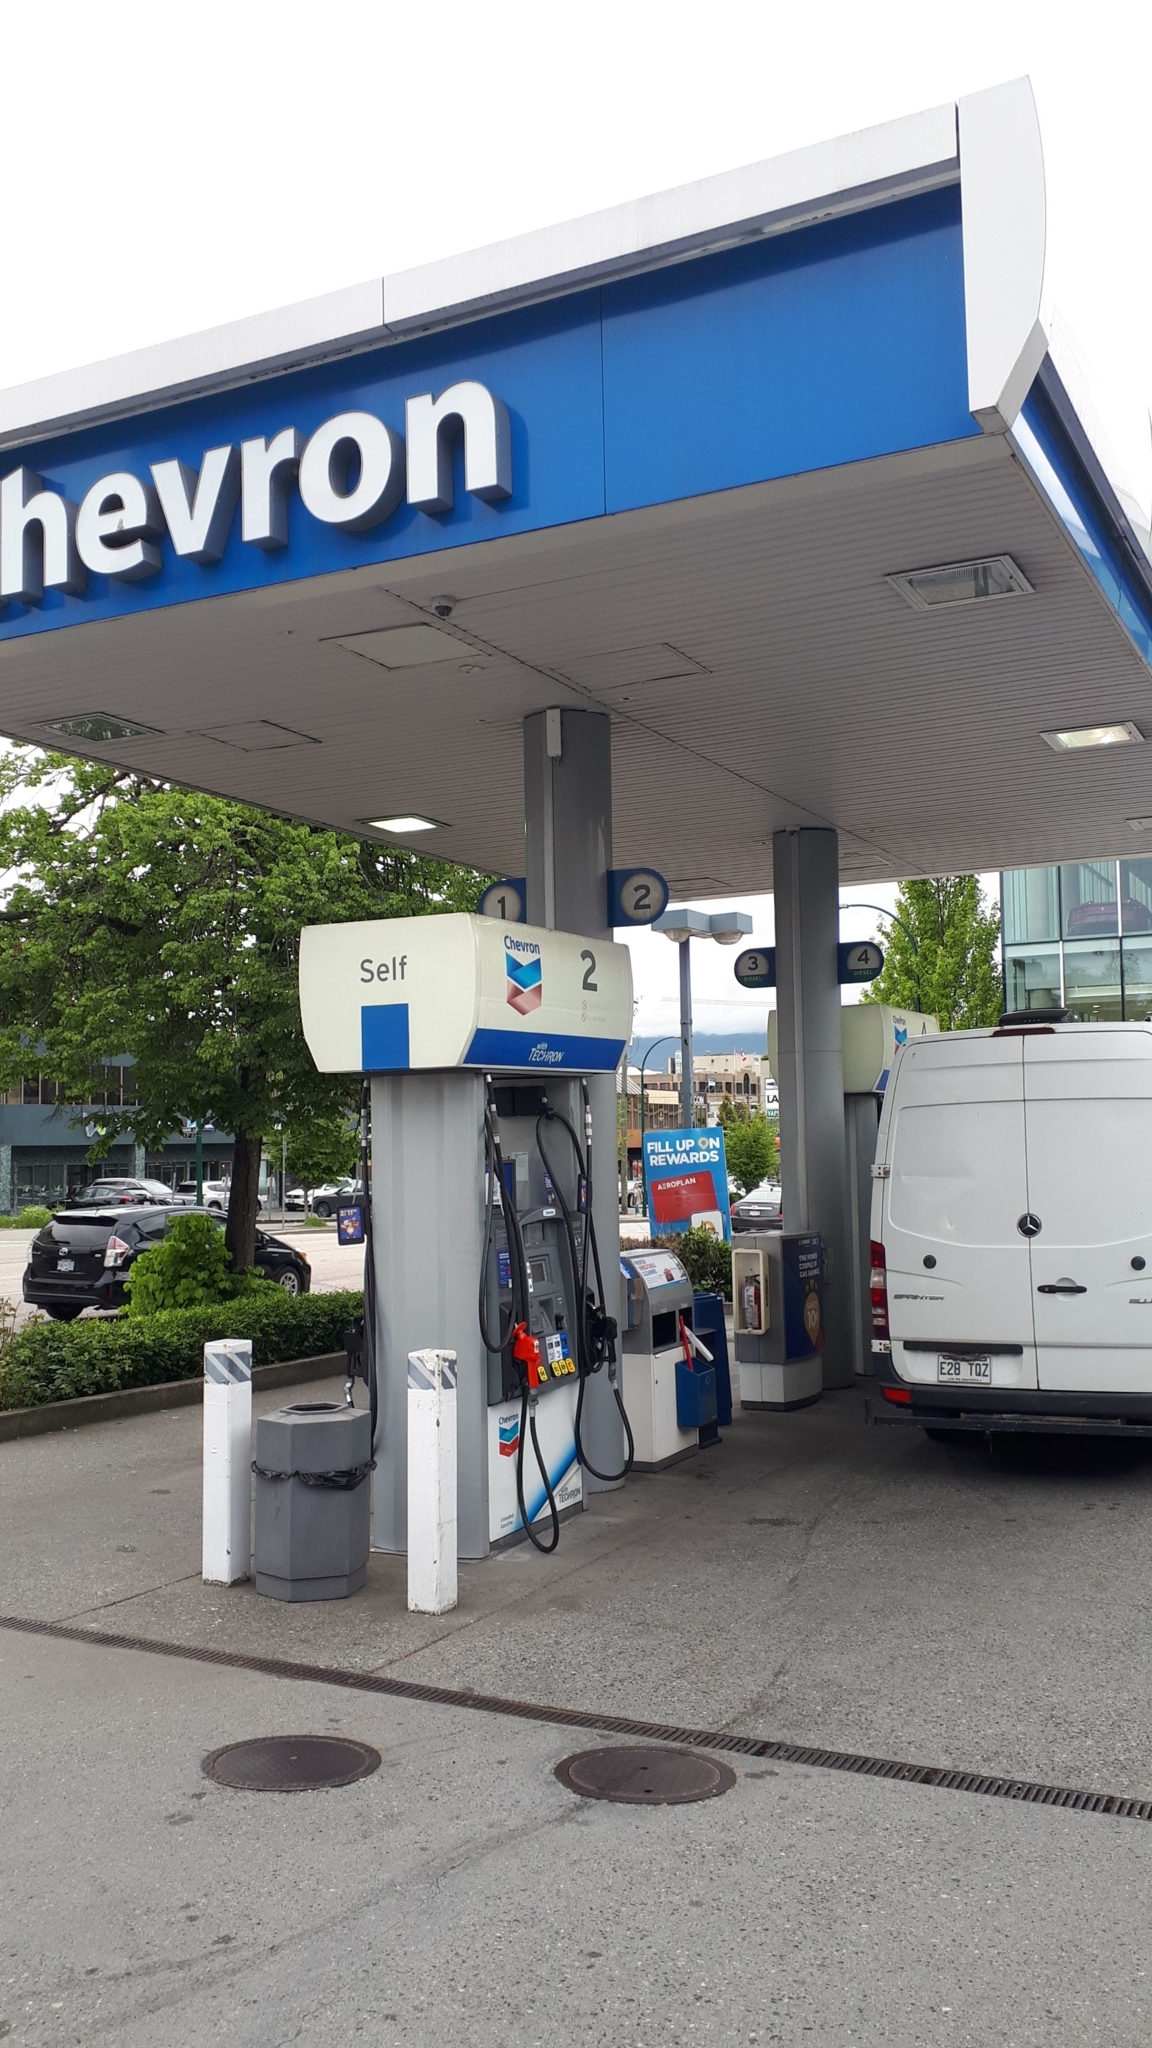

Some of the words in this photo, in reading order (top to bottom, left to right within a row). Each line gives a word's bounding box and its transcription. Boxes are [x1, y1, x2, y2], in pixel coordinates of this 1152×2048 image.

[0, 380, 511, 603] hevron
[632, 883, 652, 911] 2
[497, 896, 506, 919] 1
[504, 935, 541, 955] Chevron
[747, 955, 759, 971] 3
[857, 949, 870, 965] 4
[360, 955, 408, 984] Self
[580, 949, 598, 992] 2
[537, 1042, 548, 1051] with
[528, 1048, 565, 1064] TECHRON
[646, 1140, 674, 1154] FILL
[675, 1138, 695, 1152] UP
[698, 1136, 720, 1150] ON
[649, 1150, 719, 1167] REWARDS
[657, 1177, 696, 1191] AEROPLAN
[799, 1270, 808, 1278] GAS
[940, 1361, 961, 1376] E28
[968, 1362, 989, 1377] TQZ
[498, 1413, 519, 1425] Chevron
[558, 1487, 581, 1504] TECHRON
